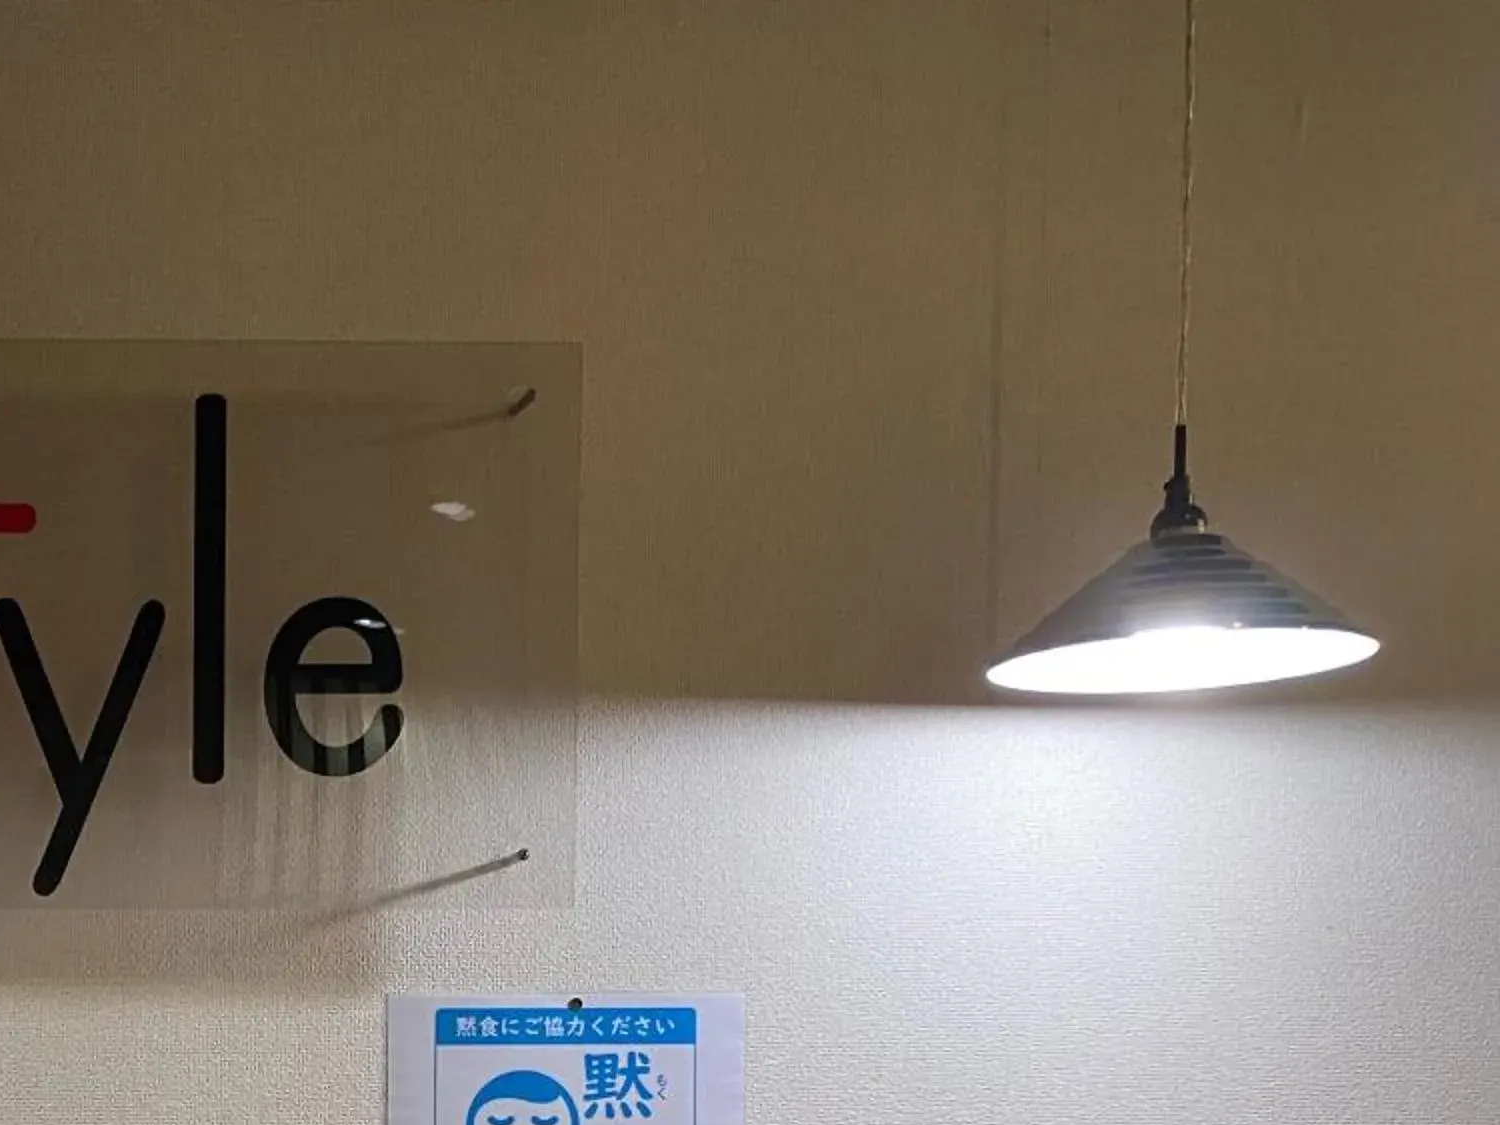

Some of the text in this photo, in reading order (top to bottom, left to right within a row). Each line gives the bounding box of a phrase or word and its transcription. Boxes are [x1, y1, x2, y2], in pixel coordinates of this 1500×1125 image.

[456, 1015, 676, 1038] 黙食にご協力ください
